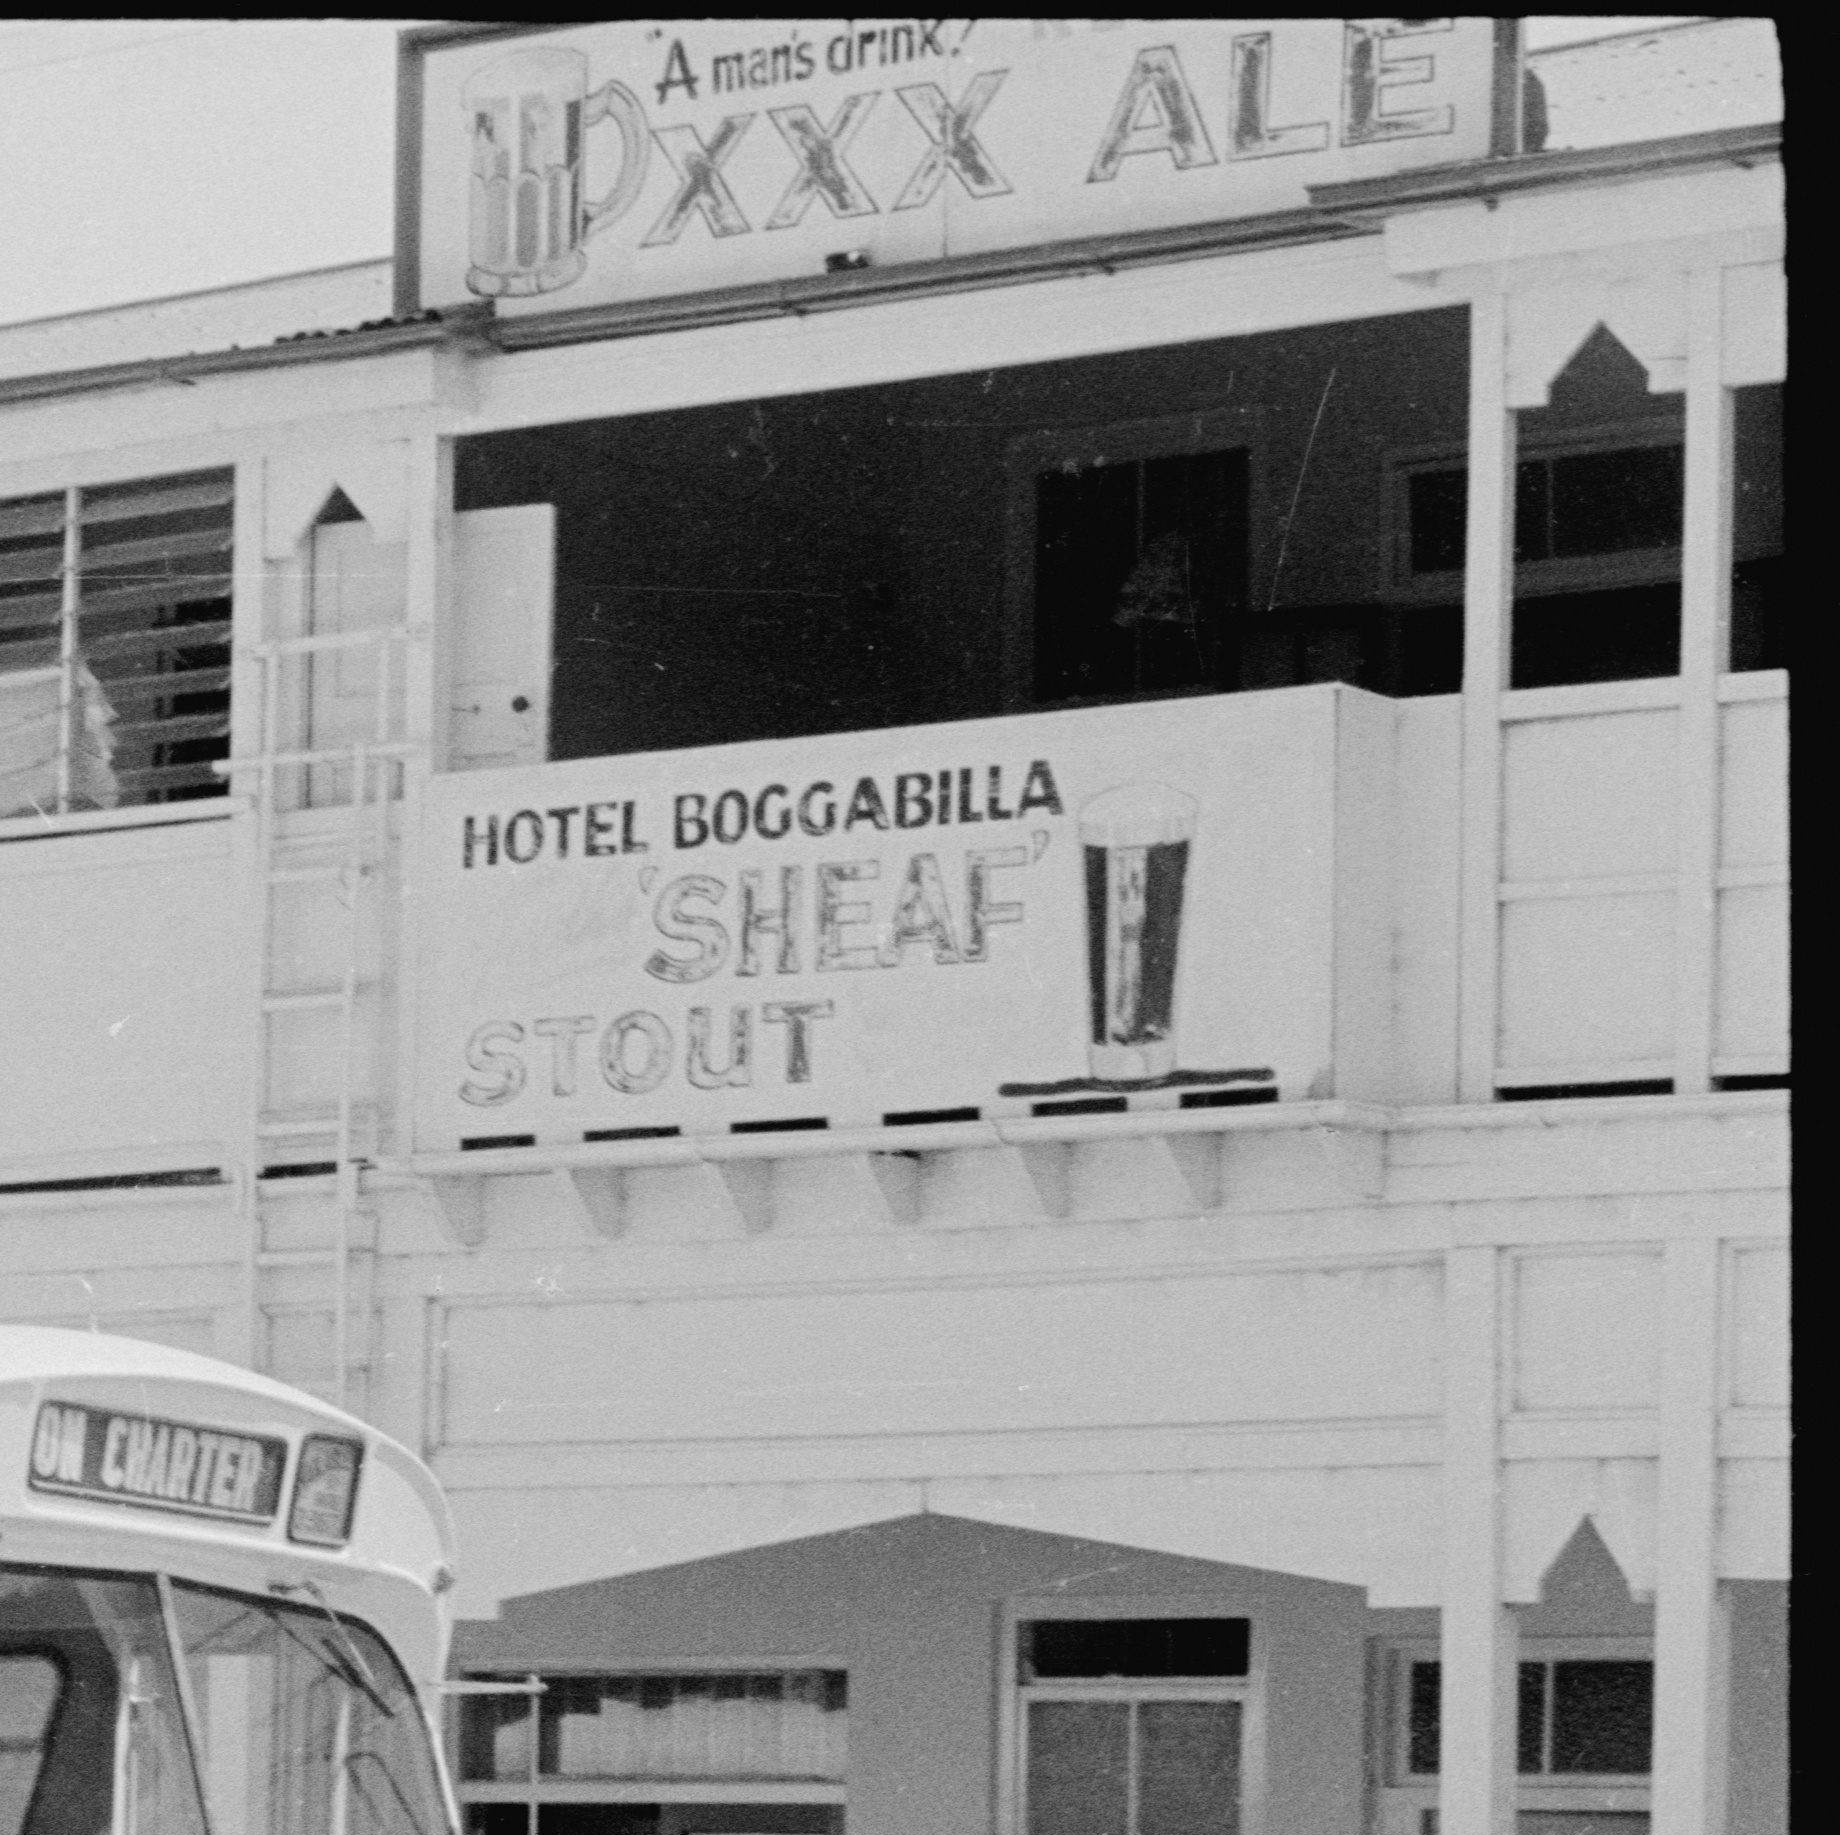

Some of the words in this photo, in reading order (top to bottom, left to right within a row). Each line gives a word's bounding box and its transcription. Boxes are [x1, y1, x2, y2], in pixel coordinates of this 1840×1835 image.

[712, 32, 815, 93] man's
[638, 68, 1013, 249] XXX
[1086, 18, 1456, 183] ALE
[460, 800, 649, 869] HOTEL
[673, 759, 1065, 850] BOGGABILLA
[459, 1000, 834, 1107] STOUT
[32, 1404, 89, 1483] ON
[100, 1415, 265, 1513] CHARTER
